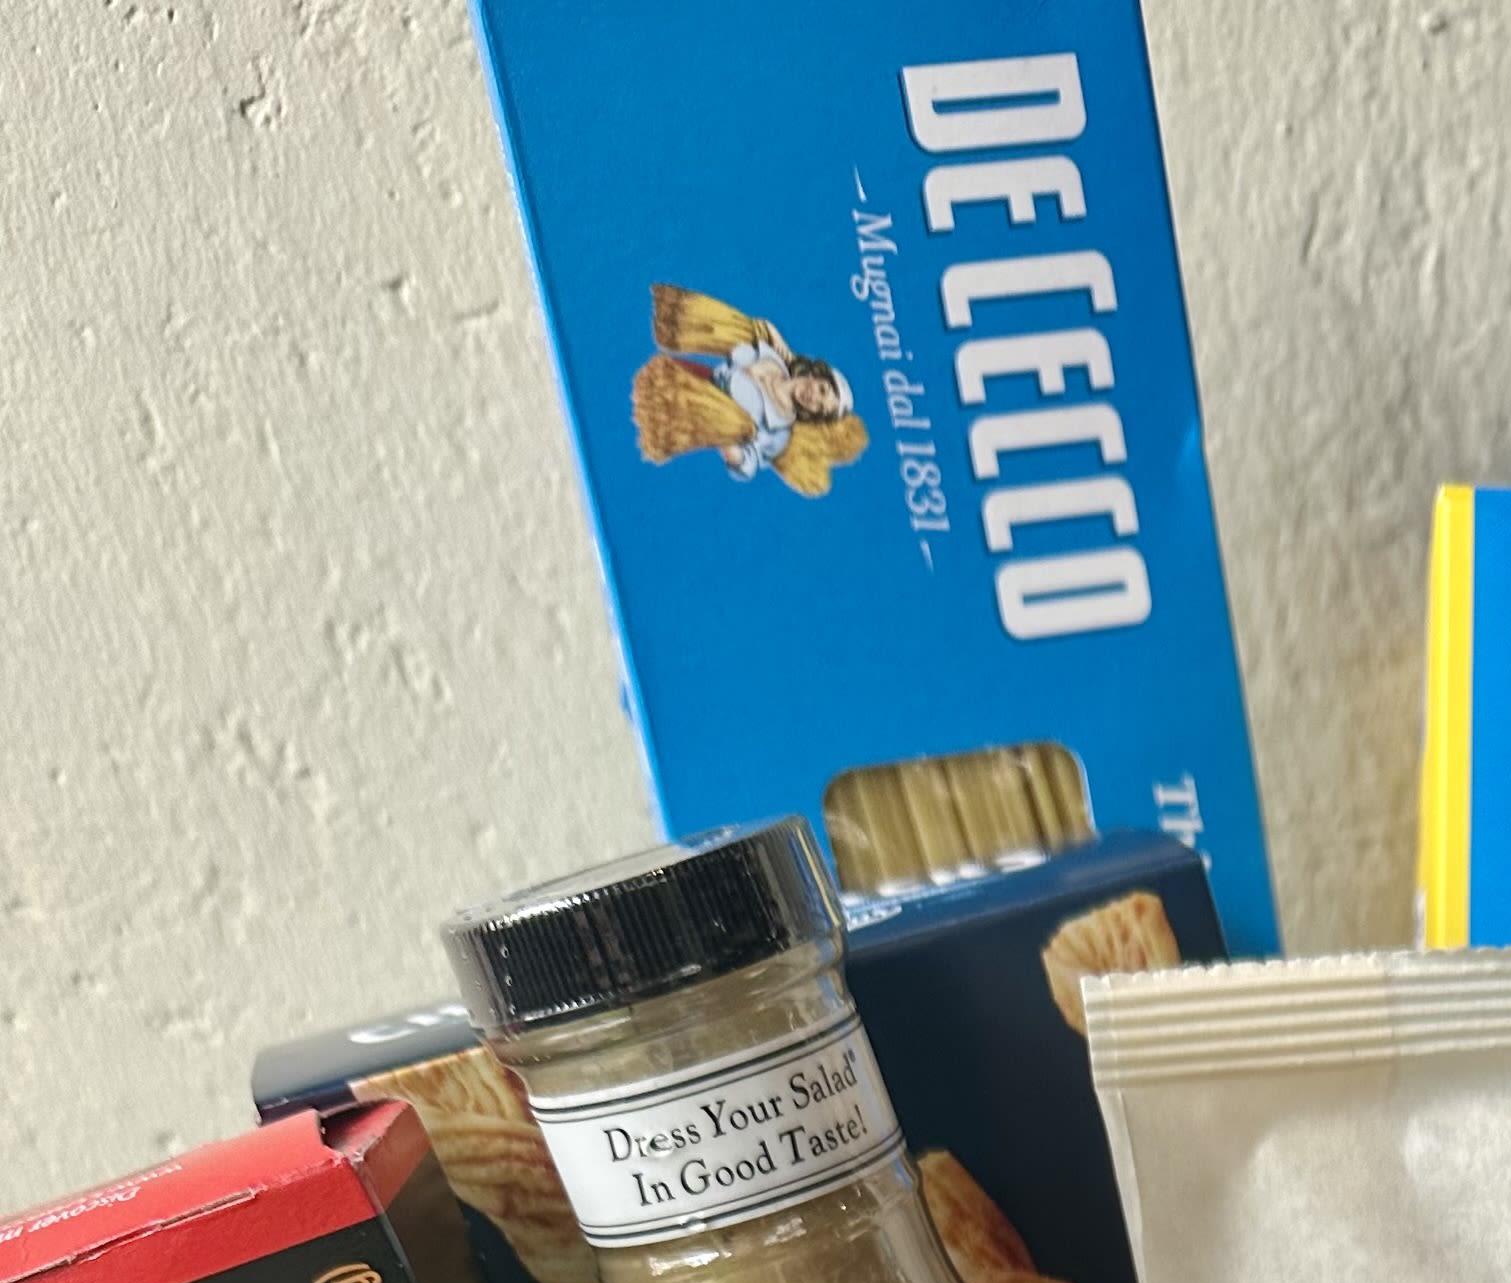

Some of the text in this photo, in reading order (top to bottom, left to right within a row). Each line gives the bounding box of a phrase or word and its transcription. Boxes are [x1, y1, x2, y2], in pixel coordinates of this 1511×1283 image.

[850, 209, 950, 532] Mugnai dal 1831
[940, 249, 1153, 642] CECCO
[603, 1123, 701, 1163] Dress
[701, 1095, 784, 1139] Your
[632, 1104, 868, 1207] In Good Taste!
